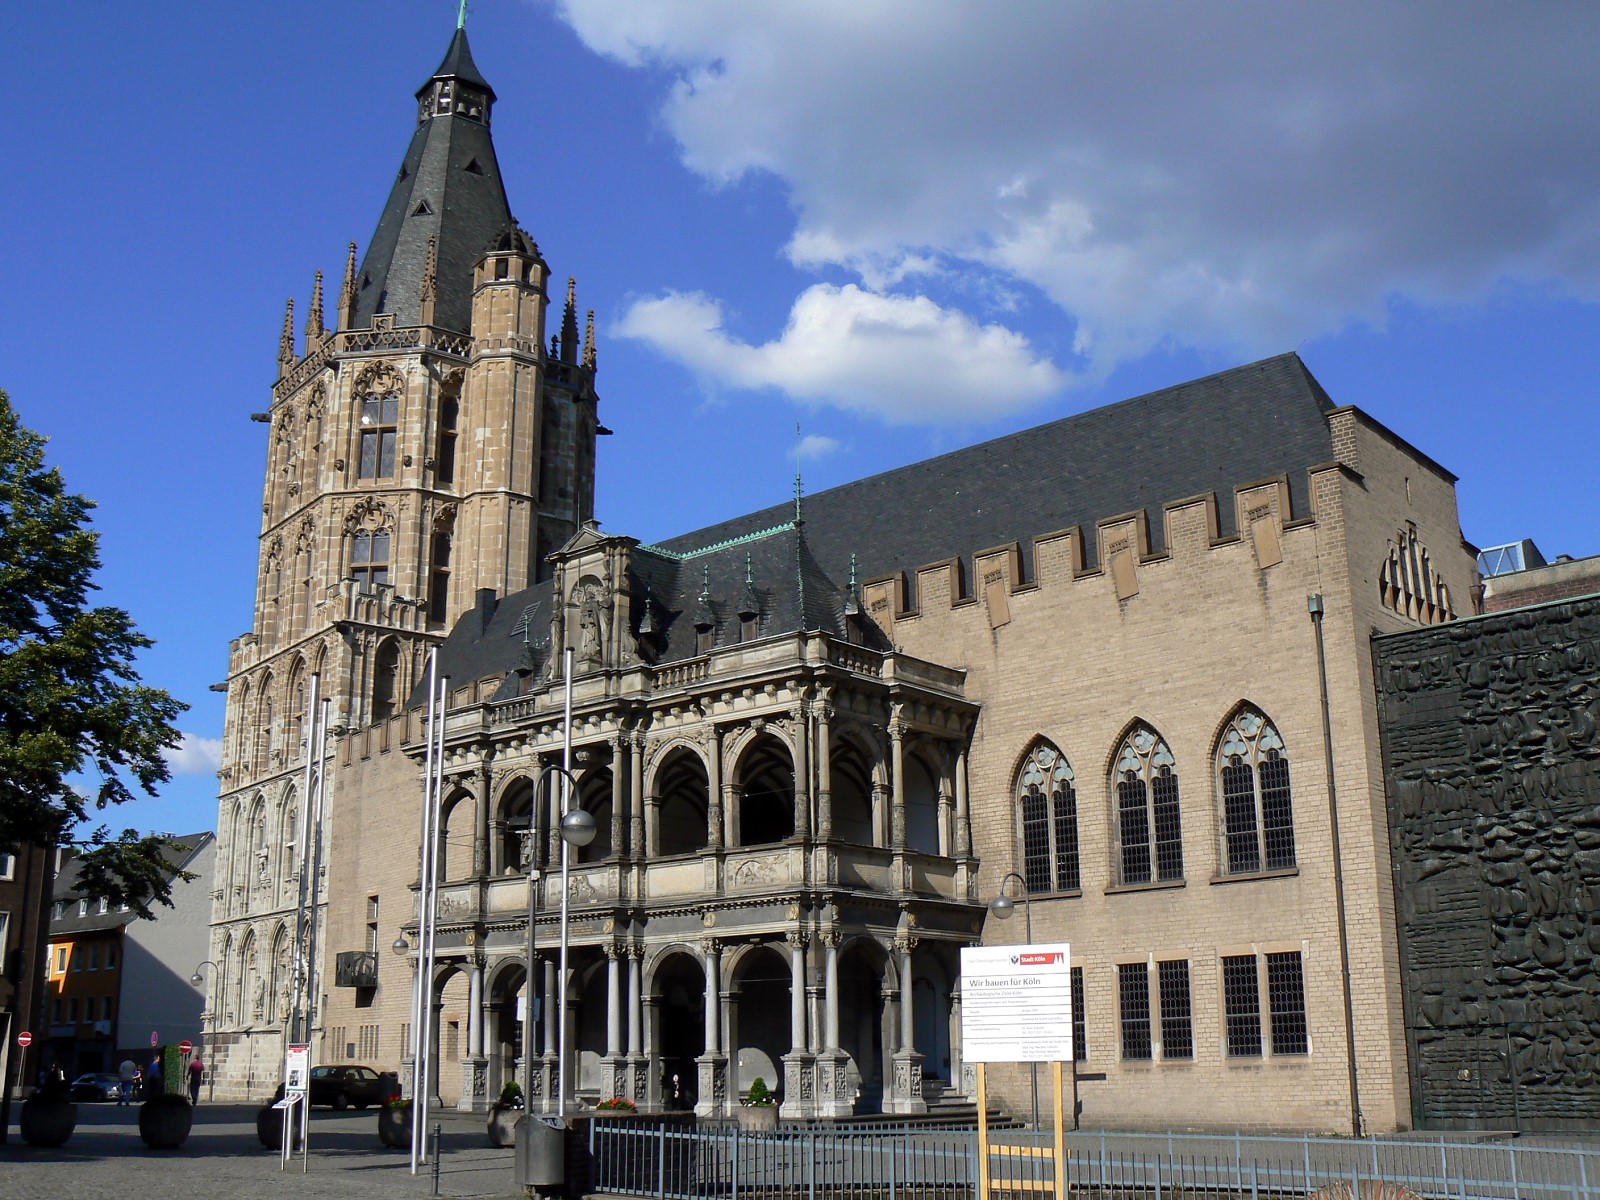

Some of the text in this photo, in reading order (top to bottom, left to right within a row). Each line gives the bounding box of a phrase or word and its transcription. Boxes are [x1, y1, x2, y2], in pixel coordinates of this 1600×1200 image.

[969, 977, 1041, 987] Wir bauen für Köln
